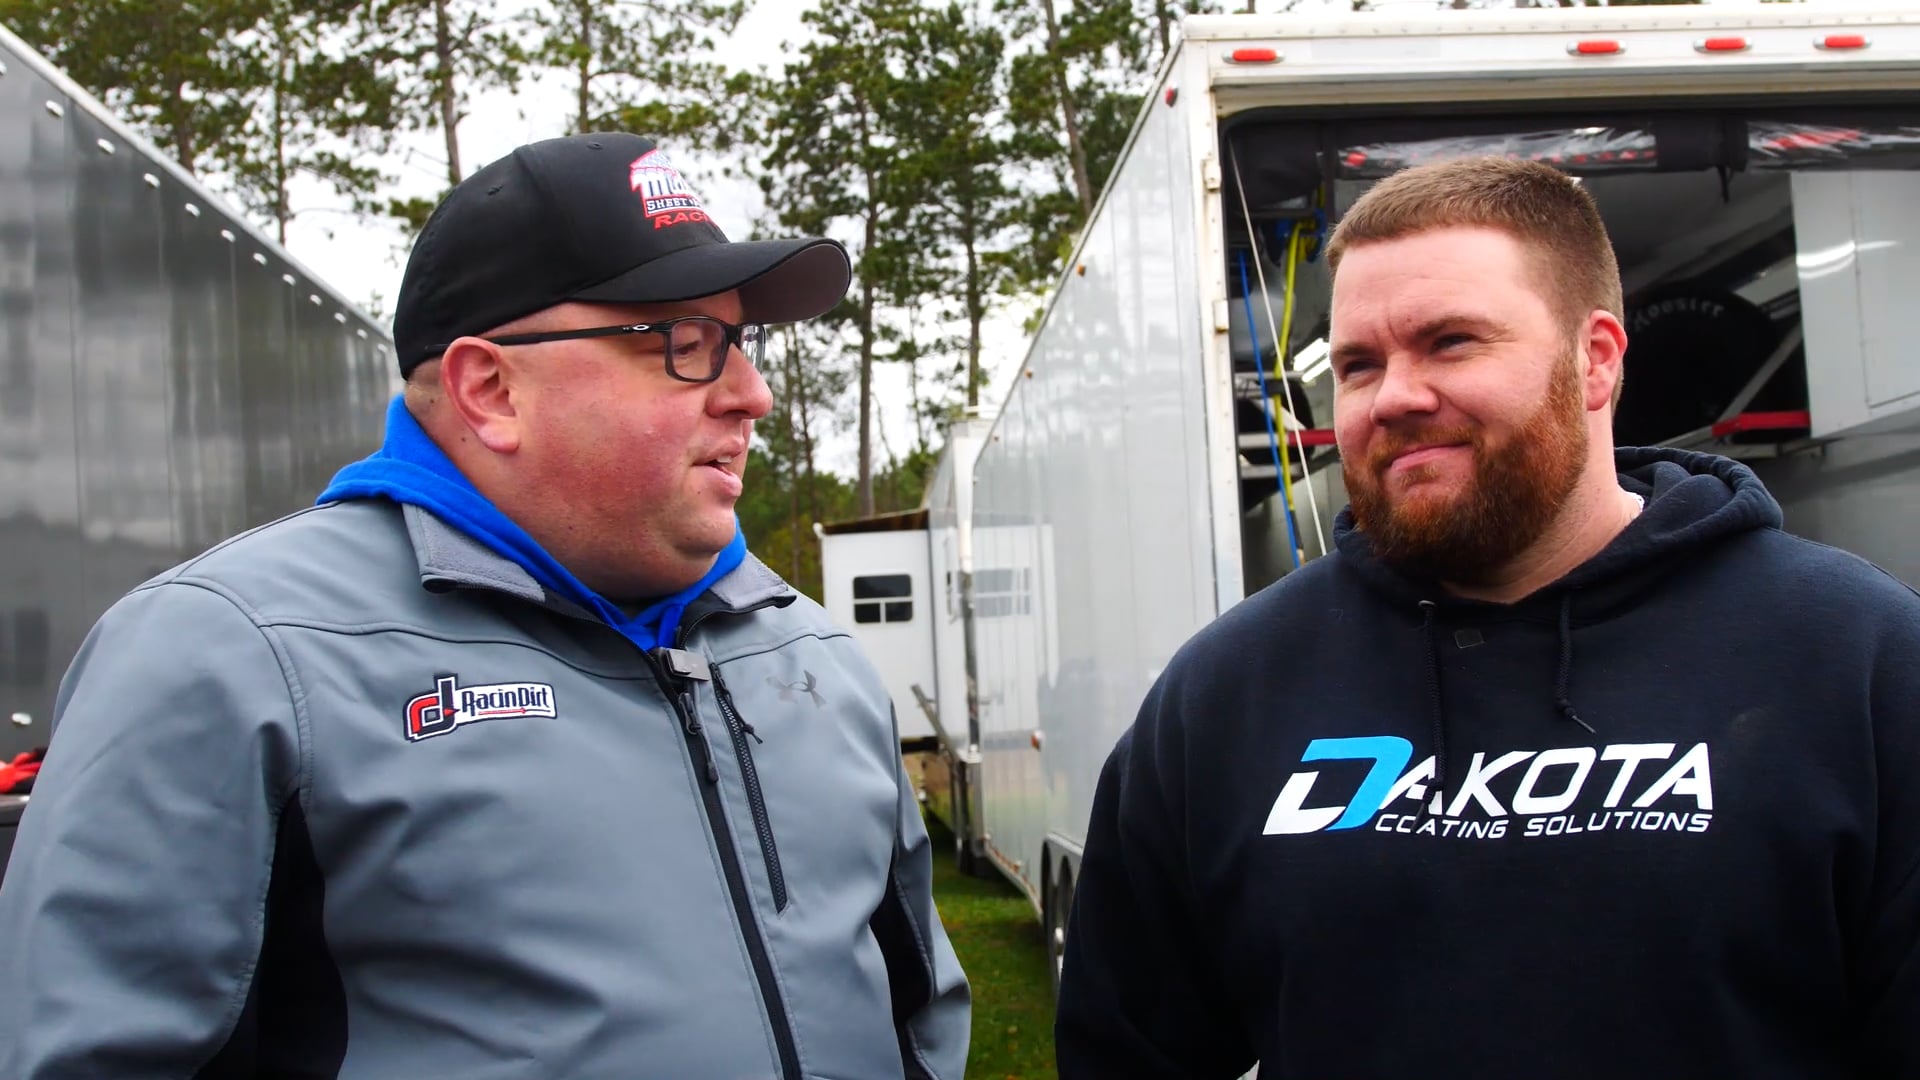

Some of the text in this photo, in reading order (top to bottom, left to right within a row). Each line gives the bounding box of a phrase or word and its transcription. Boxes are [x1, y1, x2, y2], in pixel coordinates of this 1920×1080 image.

[646, 197, 688, 211] SHEET
[461, 686, 550, 717] RacinDirt
[1262, 735, 1714, 836] DAKOTA
[1523, 811, 1713, 837] SOLUTIONS
